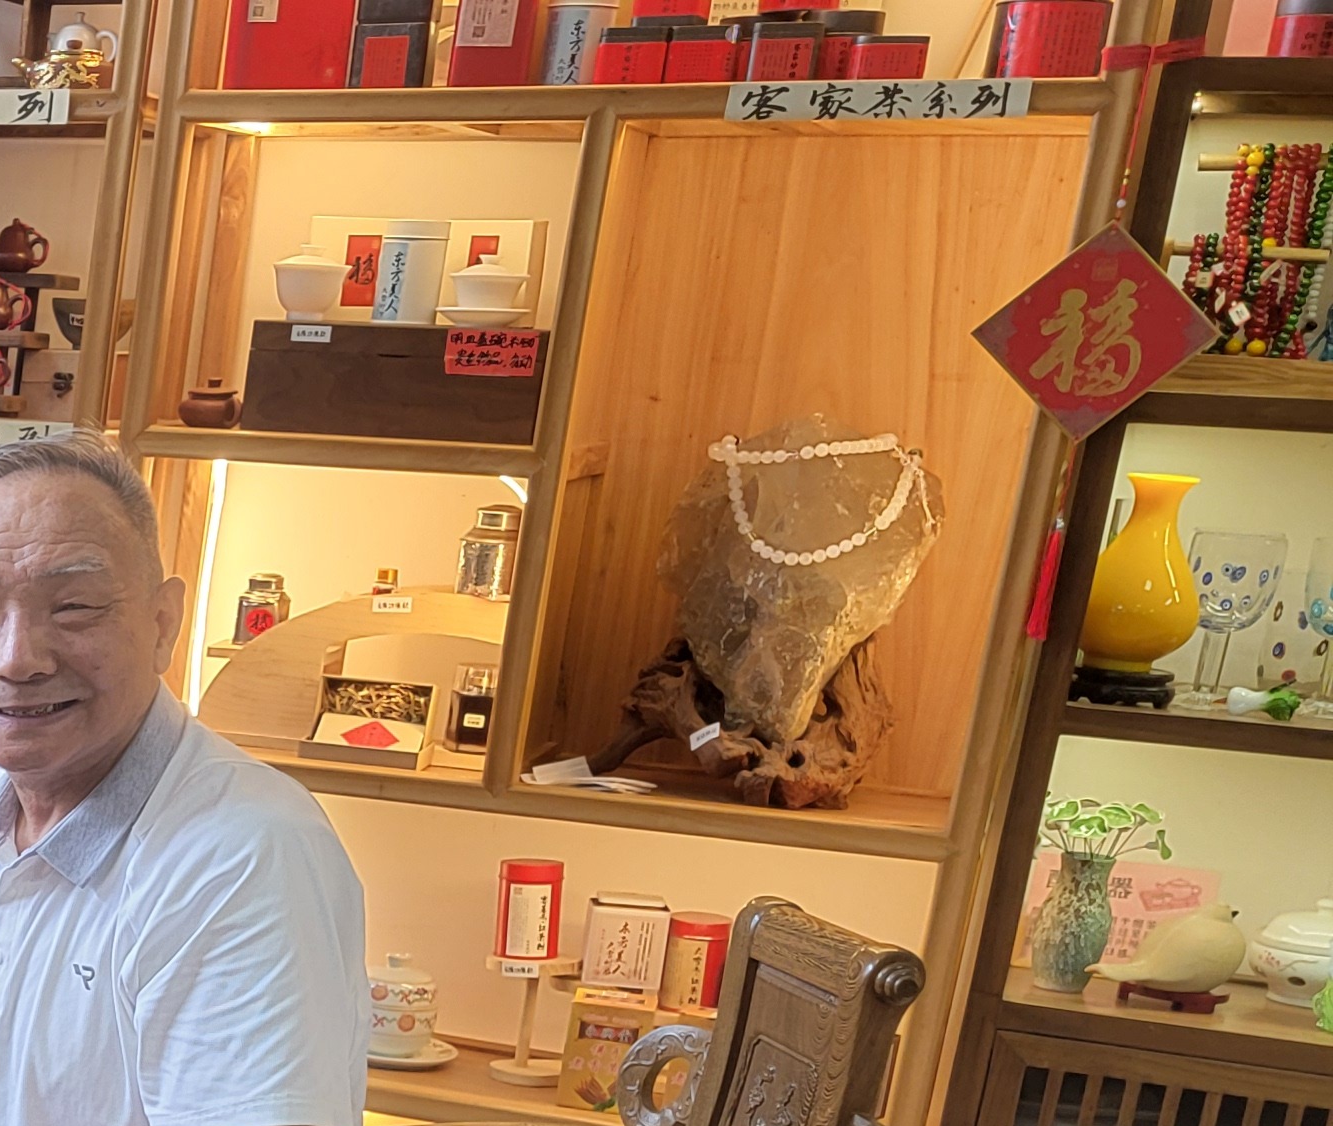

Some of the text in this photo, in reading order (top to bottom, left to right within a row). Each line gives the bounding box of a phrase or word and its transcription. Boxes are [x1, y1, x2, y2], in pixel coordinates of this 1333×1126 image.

[741, 82, 1011, 119] 客家茶系列
[1029, 278, 1142, 397] 福
